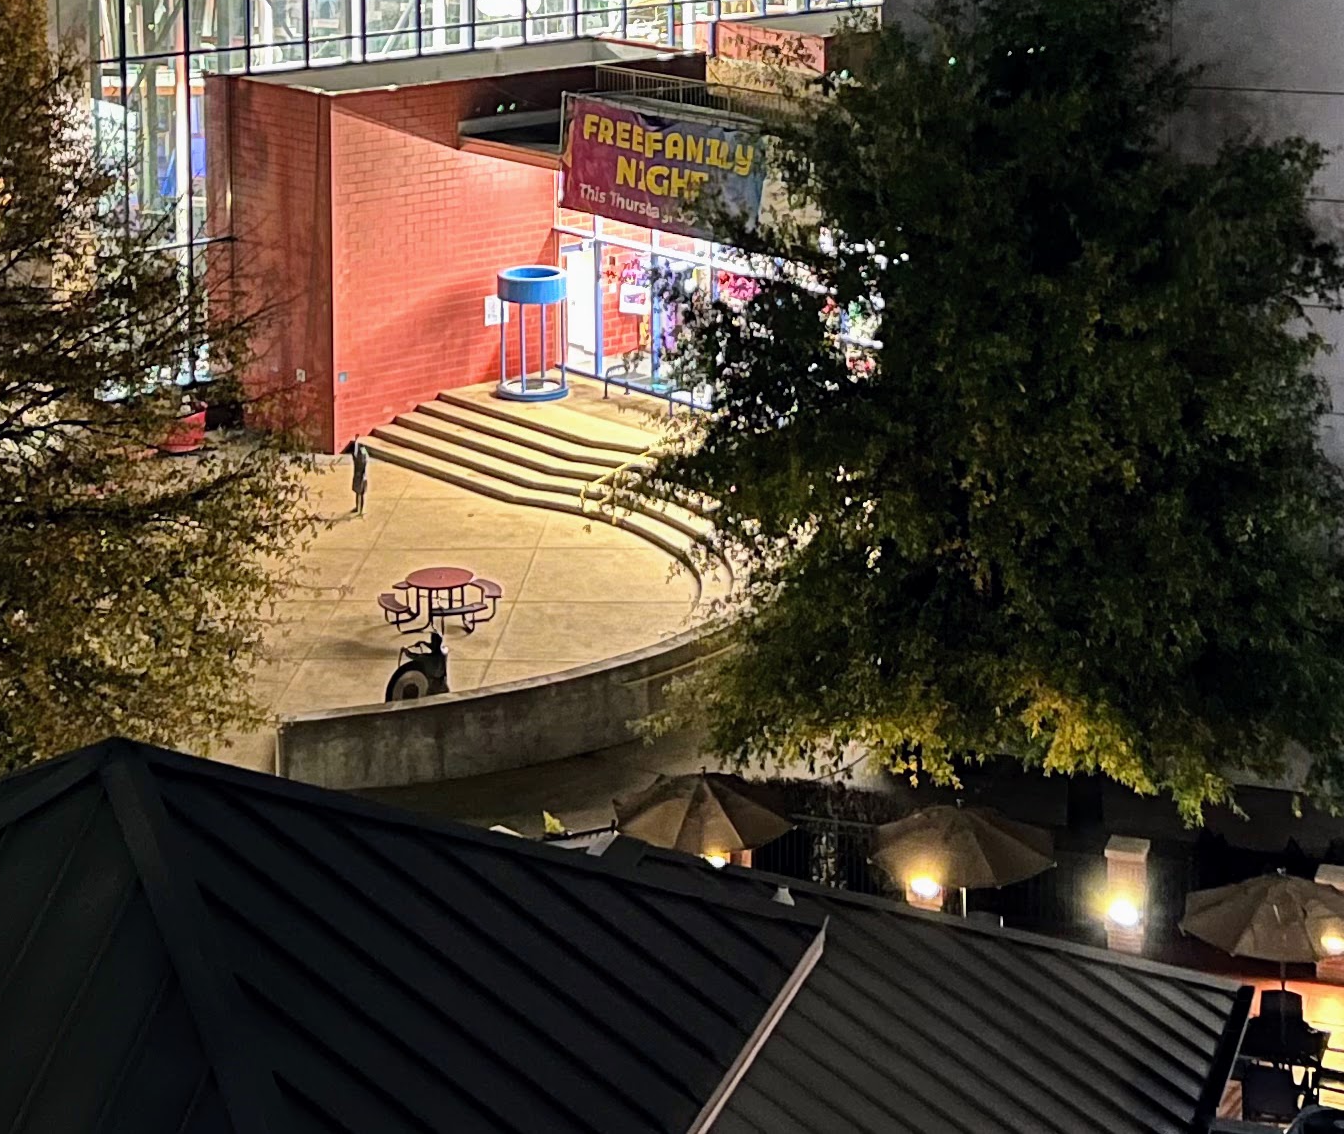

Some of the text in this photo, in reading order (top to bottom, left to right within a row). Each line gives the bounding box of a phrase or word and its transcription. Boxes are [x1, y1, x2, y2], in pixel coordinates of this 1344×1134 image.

[582, 113, 754, 176] FREE FAMILY
[579, 182, 607, 204] This
[615, 155, 709, 200] NIGHT
